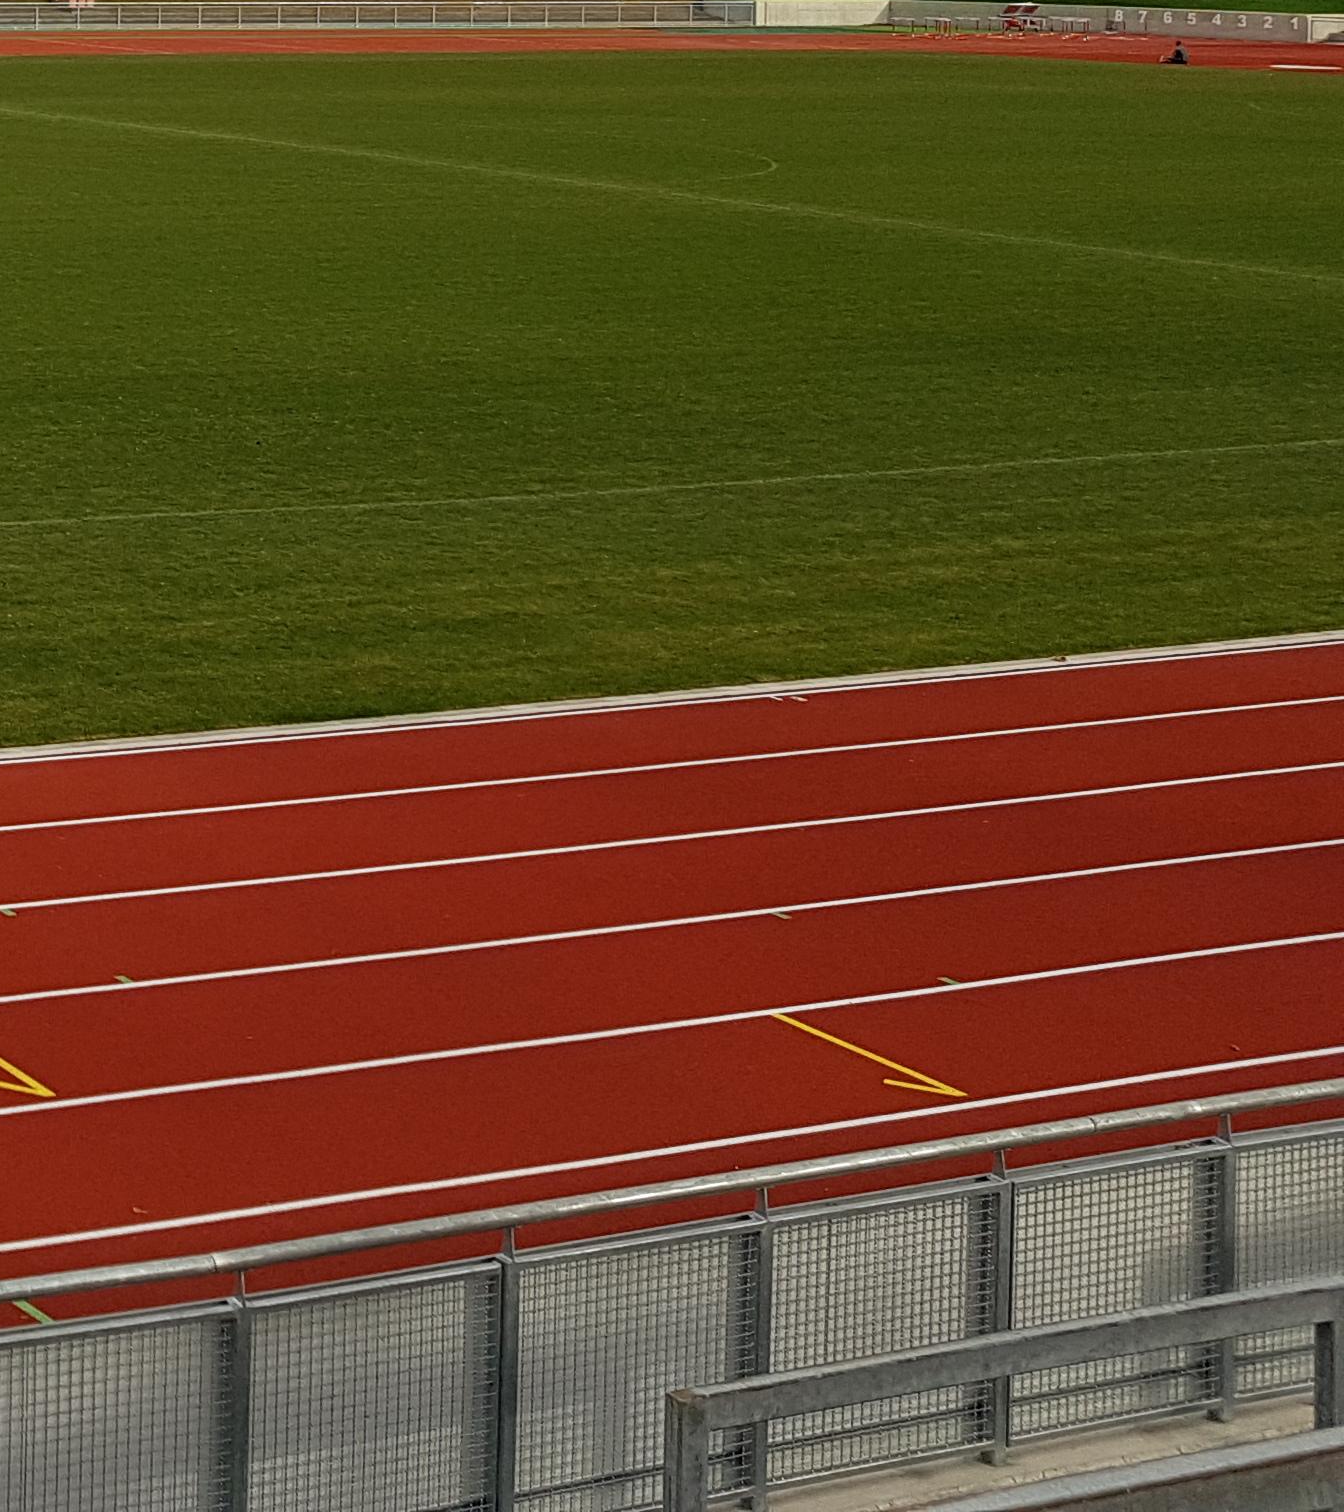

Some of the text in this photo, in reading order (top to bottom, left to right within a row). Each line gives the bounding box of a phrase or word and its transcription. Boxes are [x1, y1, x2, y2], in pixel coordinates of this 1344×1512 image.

[1114, 9, 1299, 30] 8 7 6 5 4 3 2 1
